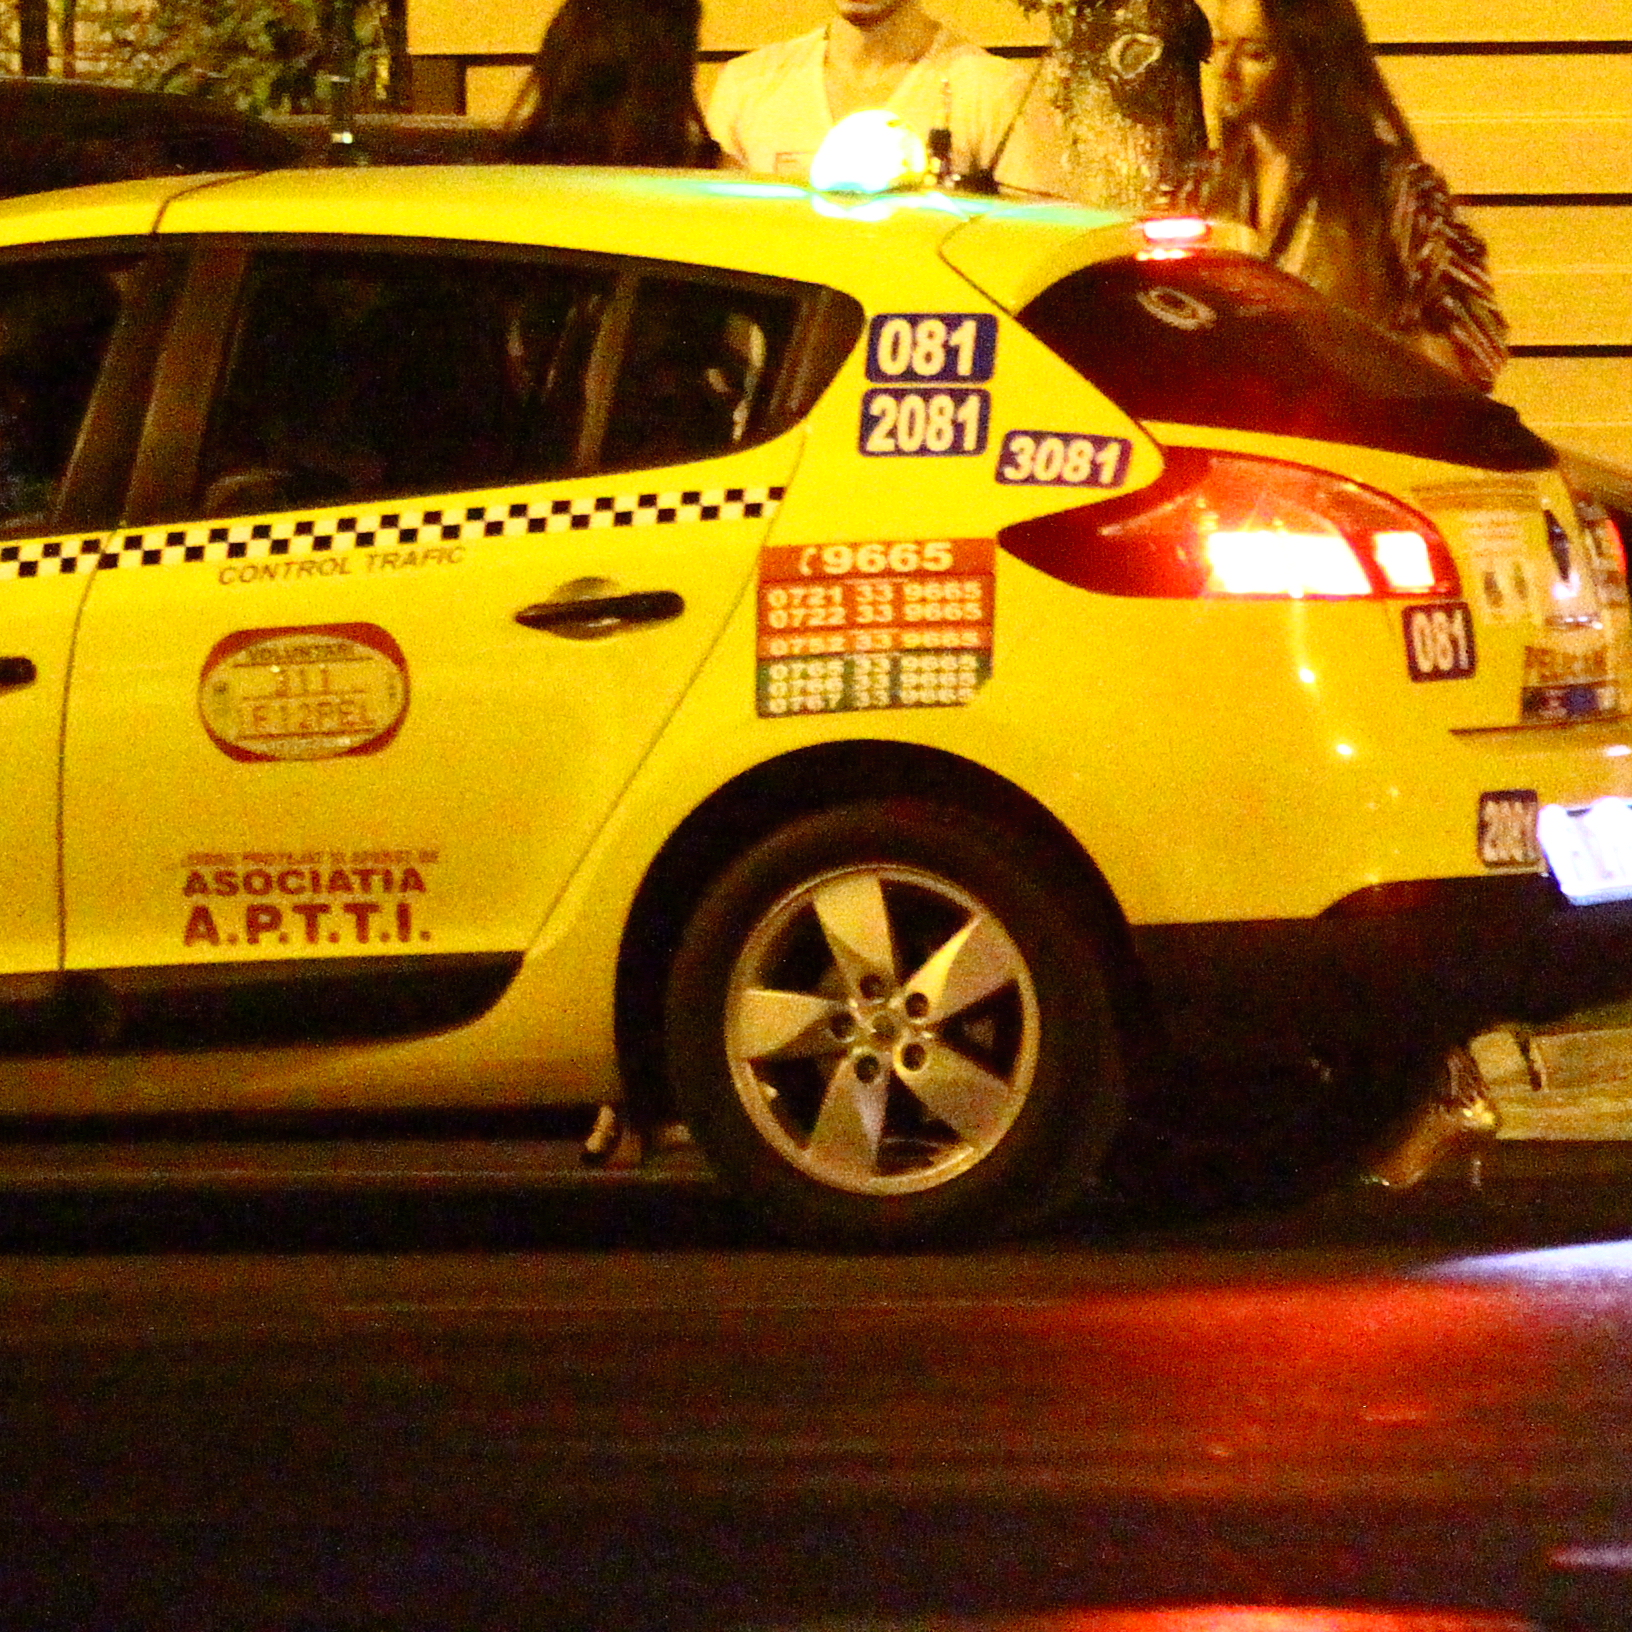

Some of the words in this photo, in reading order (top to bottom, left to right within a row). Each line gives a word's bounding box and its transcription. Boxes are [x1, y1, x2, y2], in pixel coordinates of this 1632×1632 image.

[877, 318, 977, 376] 081
[866, 394, 981, 452] 2081
[1003, 435, 1122, 484] 3081
[218, 558, 351, 585] CONTROL
[368, 546, 466, 574] TRAFIC
[822, 541, 954, 575] 9665
[768, 585, 843, 607] 0721
[854, 583, 894, 602] 33
[902, 580, 982, 601] 9665
[768, 607, 846, 628] 0722
[855, 603, 893, 623] 33
[903, 602, 982, 622] 9665
[1411, 608, 1469, 673] 081
[183, 867, 427, 898] ASOCIATIA
[183, 902, 431, 947] A.P.T.T.I.
